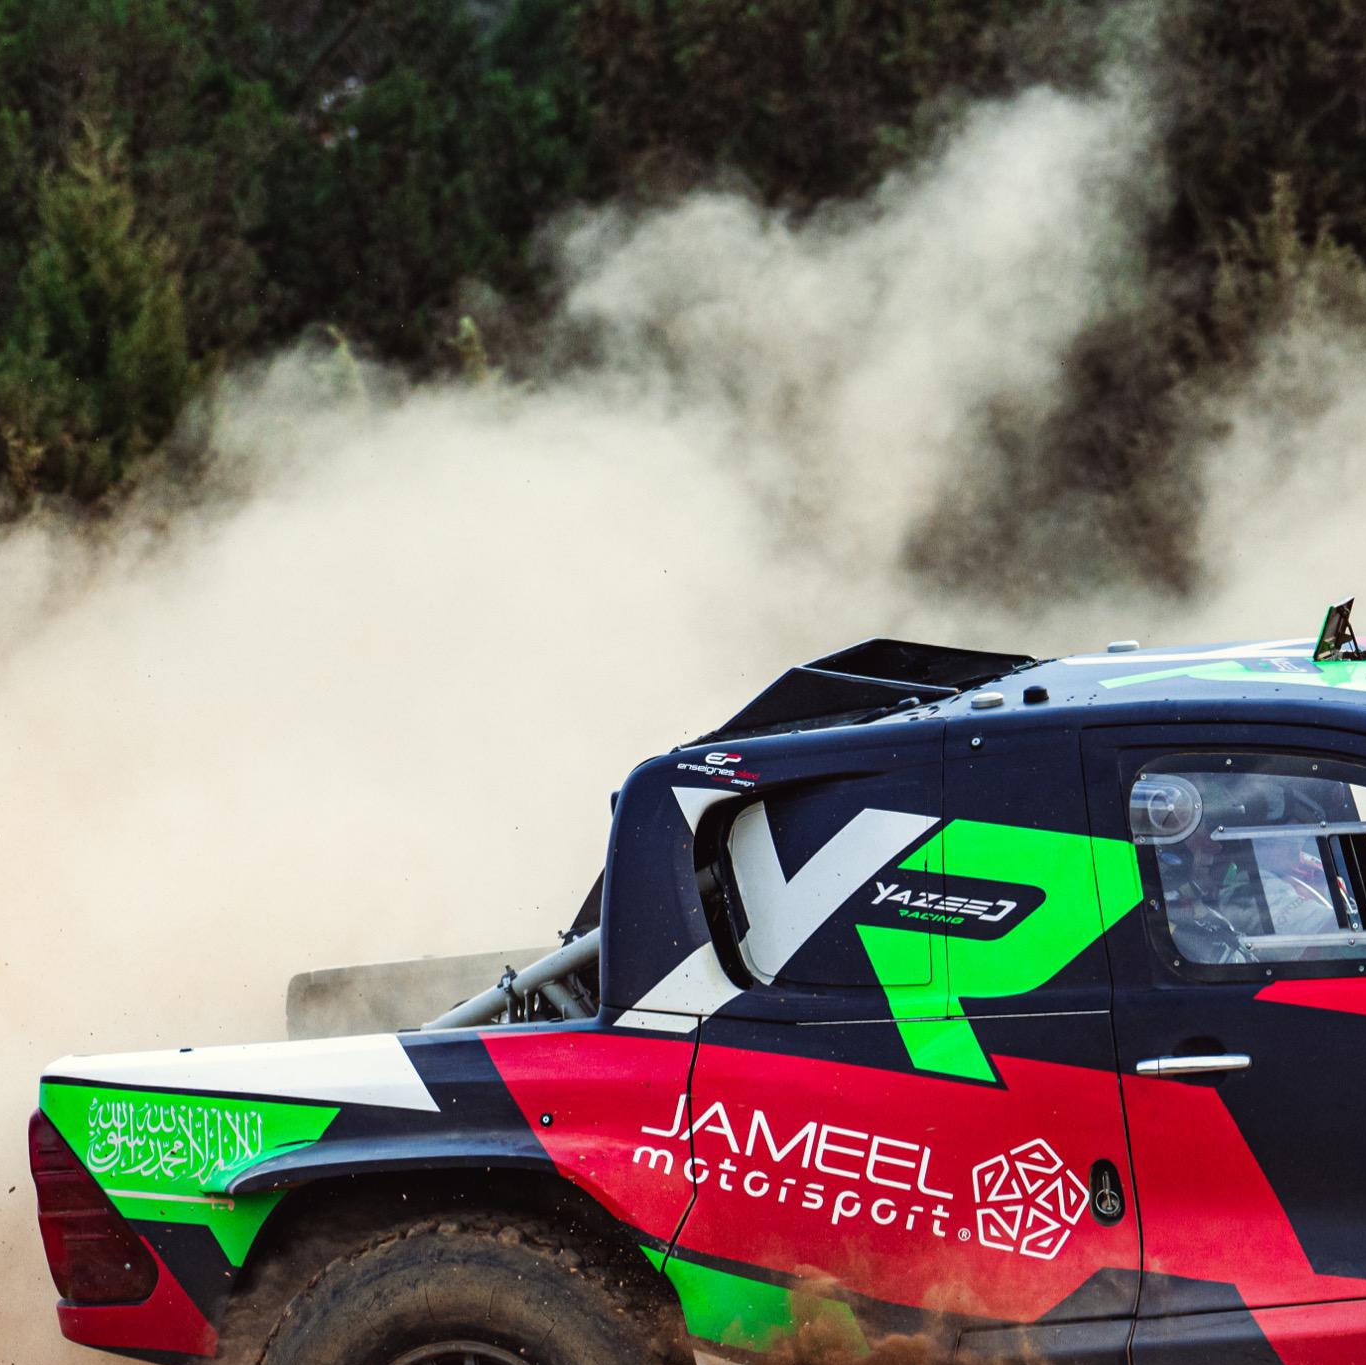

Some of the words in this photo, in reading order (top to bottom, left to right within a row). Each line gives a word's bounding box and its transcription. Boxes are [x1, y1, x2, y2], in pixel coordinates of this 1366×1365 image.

[871, 881, 1017, 922] YAZEED
[898, 909, 965, 925] RACING
[641, 1094, 953, 1200] JAMEEL
